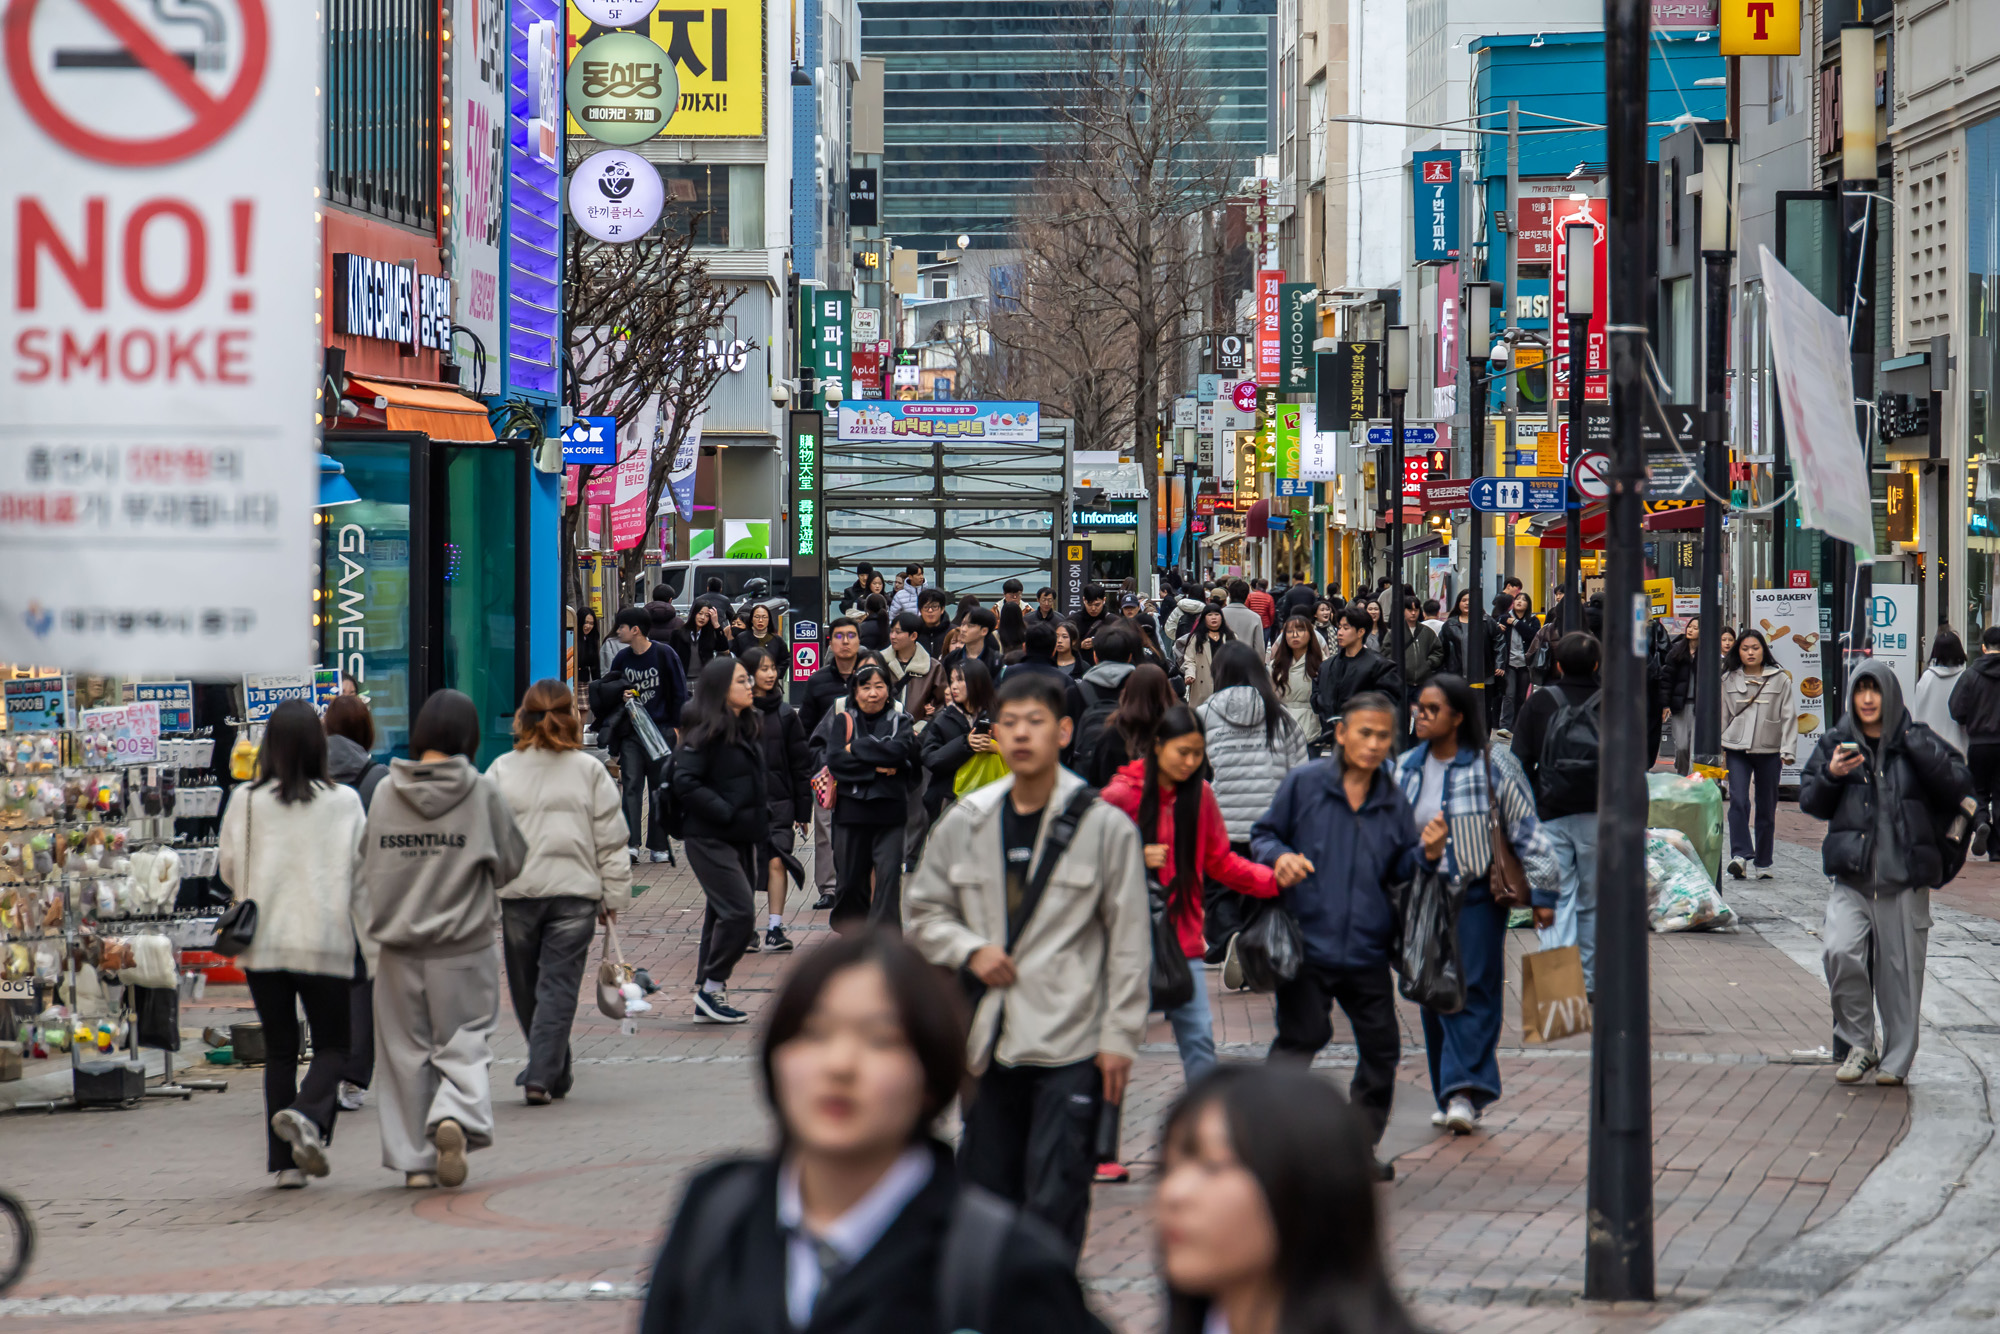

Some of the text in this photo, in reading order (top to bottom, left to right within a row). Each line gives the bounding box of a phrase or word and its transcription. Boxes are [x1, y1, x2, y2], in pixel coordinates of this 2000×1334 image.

[608, 9, 623, 19] 5F
[1747, 2, 1774, 40] T
[589, 108, 654, 121] 베이커리 카페
[587, 206, 645, 219] 한끼플러스
[1433, 185, 1446, 251] 7번가피자
[608, 225, 622, 235] 2F
[16, 197, 254, 312] NO!
[1292, 290, 1304, 373] CROCODIL
[15, 328, 253, 383] SMOKE
[1351, 355, 1366, 419] 한국공인금거래소
[850, 426, 887, 435] 22개 상점
[894, 418, 933, 435] 캐릭터
[935, 420, 984, 436] 스트리트
[799, 434, 814, 490] 購物天堂
[1244, 454, 1255, 488] 럭셔리
[338, 524, 365, 684] GAMES
[1756, 593, 1812, 602] SAO BAKERY
[802, 629, 816, 637] 580
[249, 688, 311, 702] 1개 5900원
[7, 697, 45, 713] 7900원
